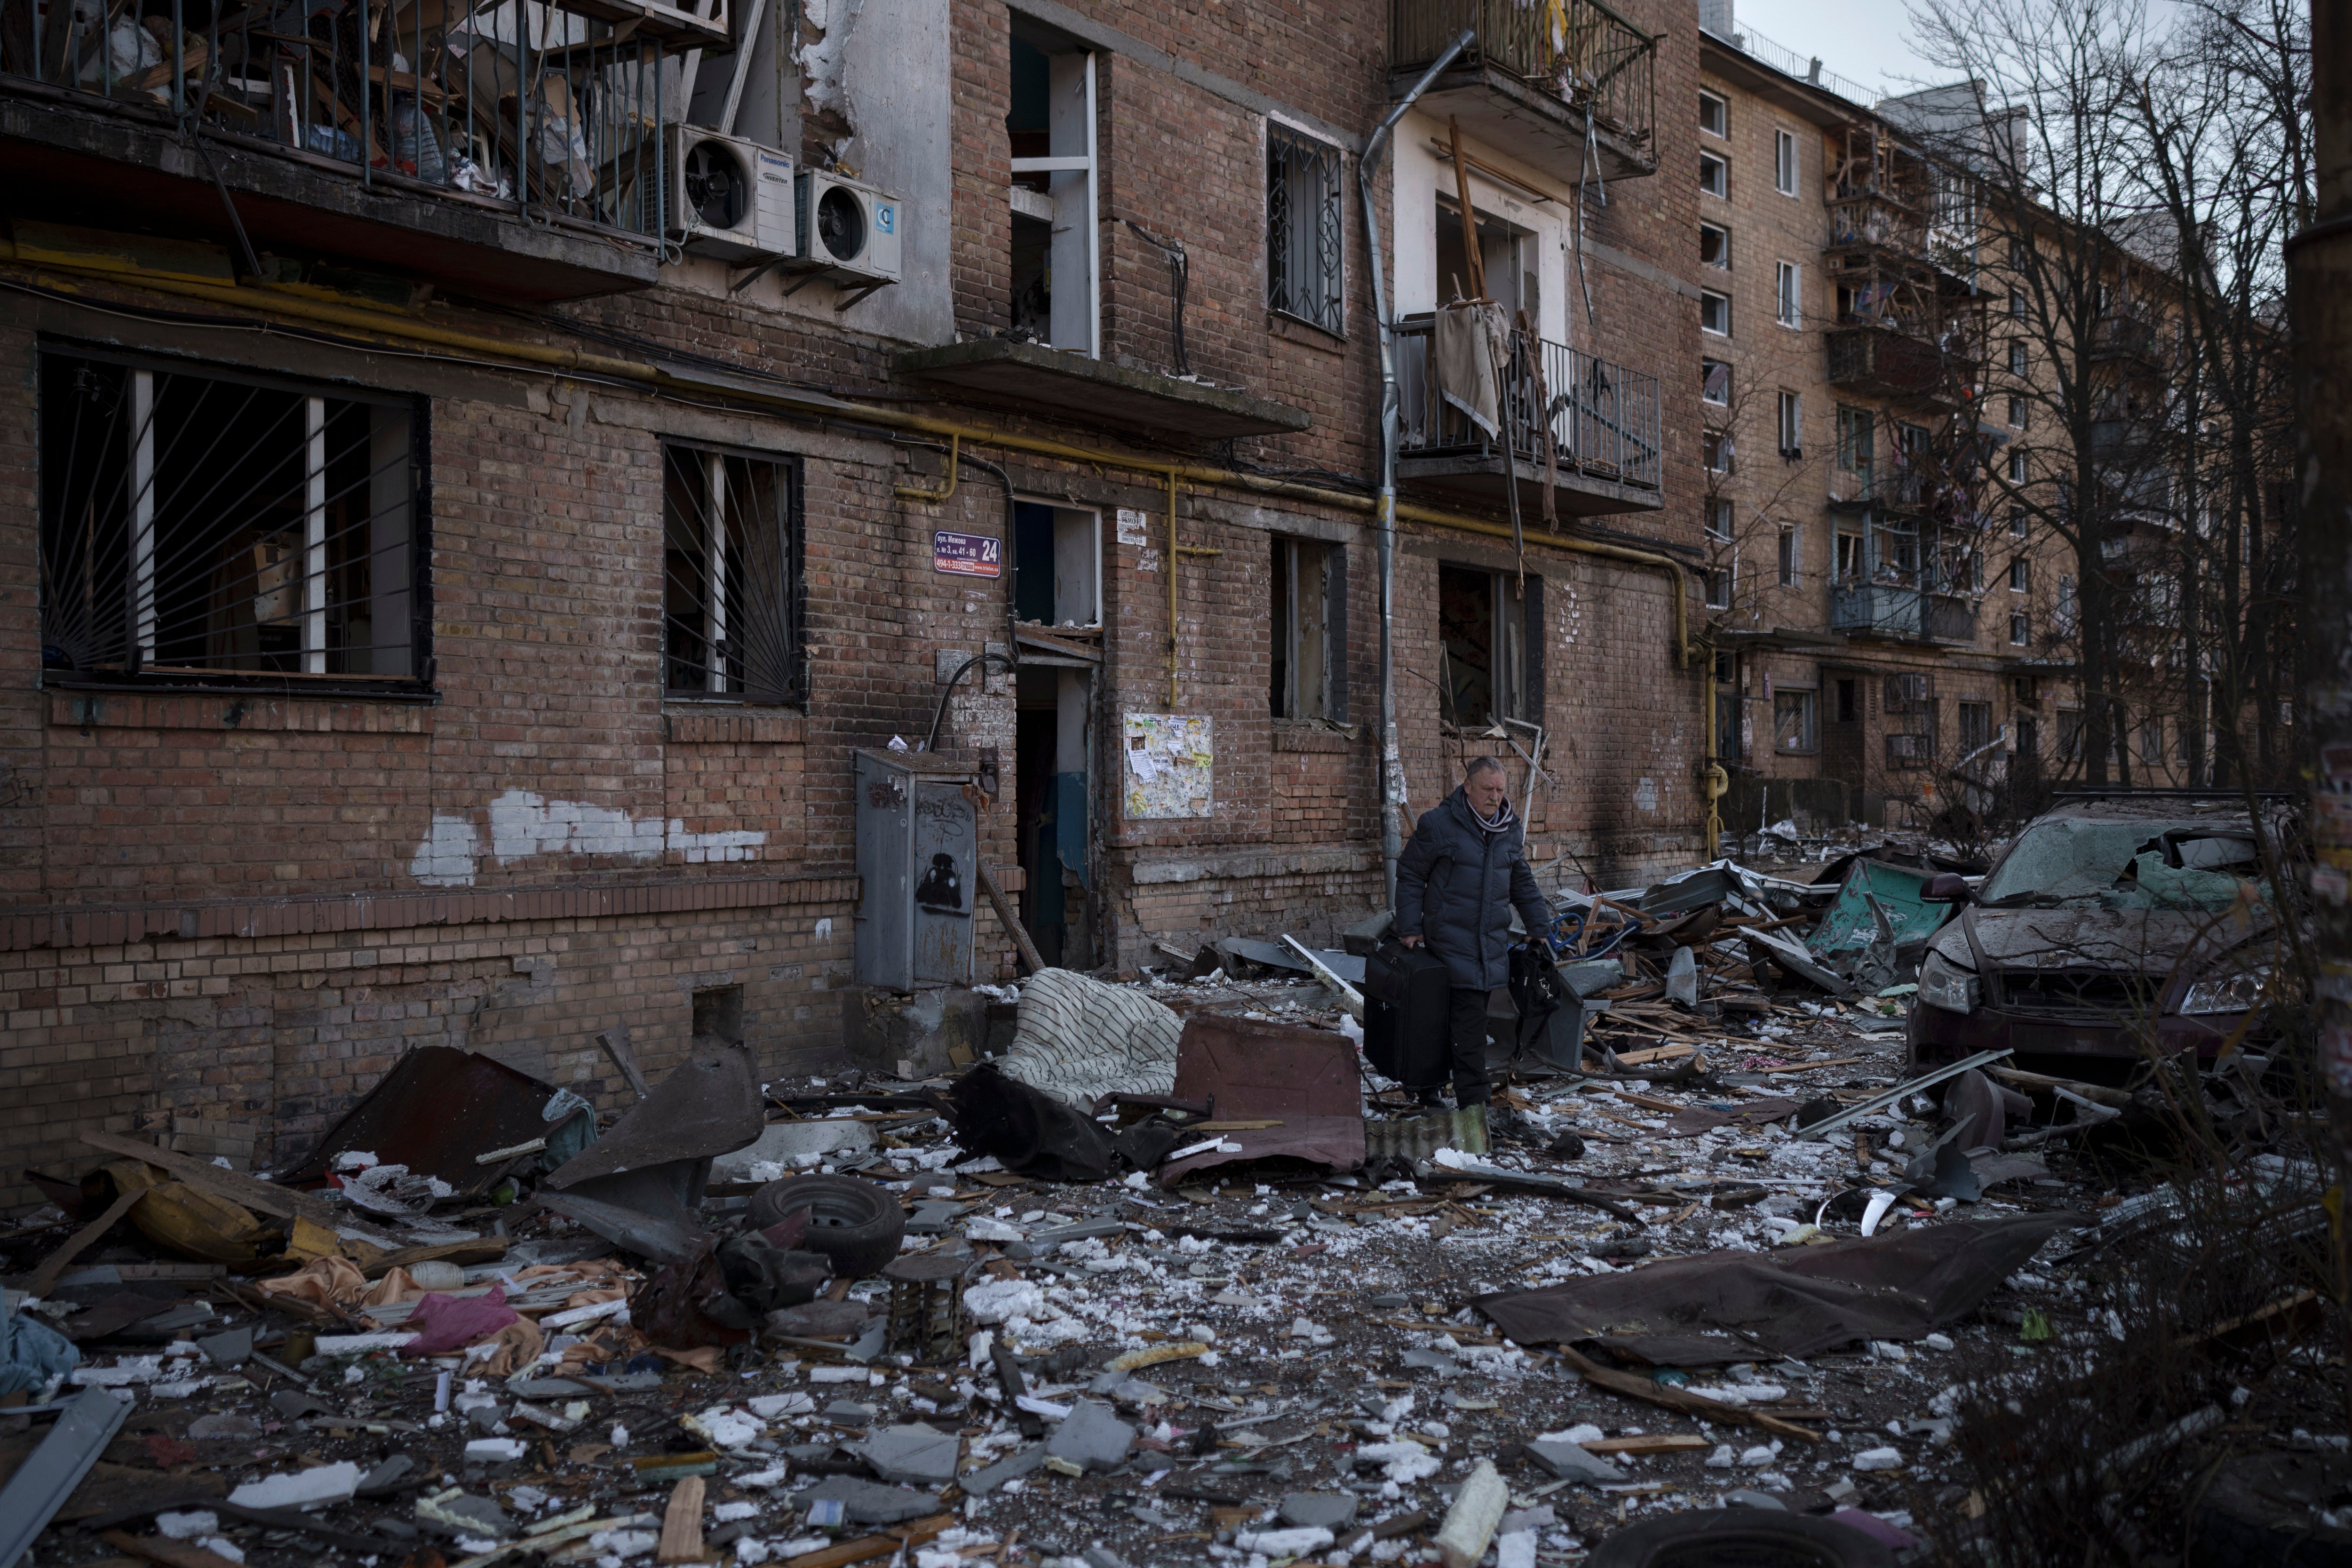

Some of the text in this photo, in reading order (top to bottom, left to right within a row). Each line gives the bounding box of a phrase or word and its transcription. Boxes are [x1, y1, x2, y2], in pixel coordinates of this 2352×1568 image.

[761, 153, 789, 168] Panasonic
[938, 535, 966, 545] вул. Межова
[947, 545, 952, 555] 3,
[959, 547, 965, 556] 41
[969, 548, 976, 557] 60
[982, 541, 997, 562] 24
[937, 559, 961, 569] 494-1-333
